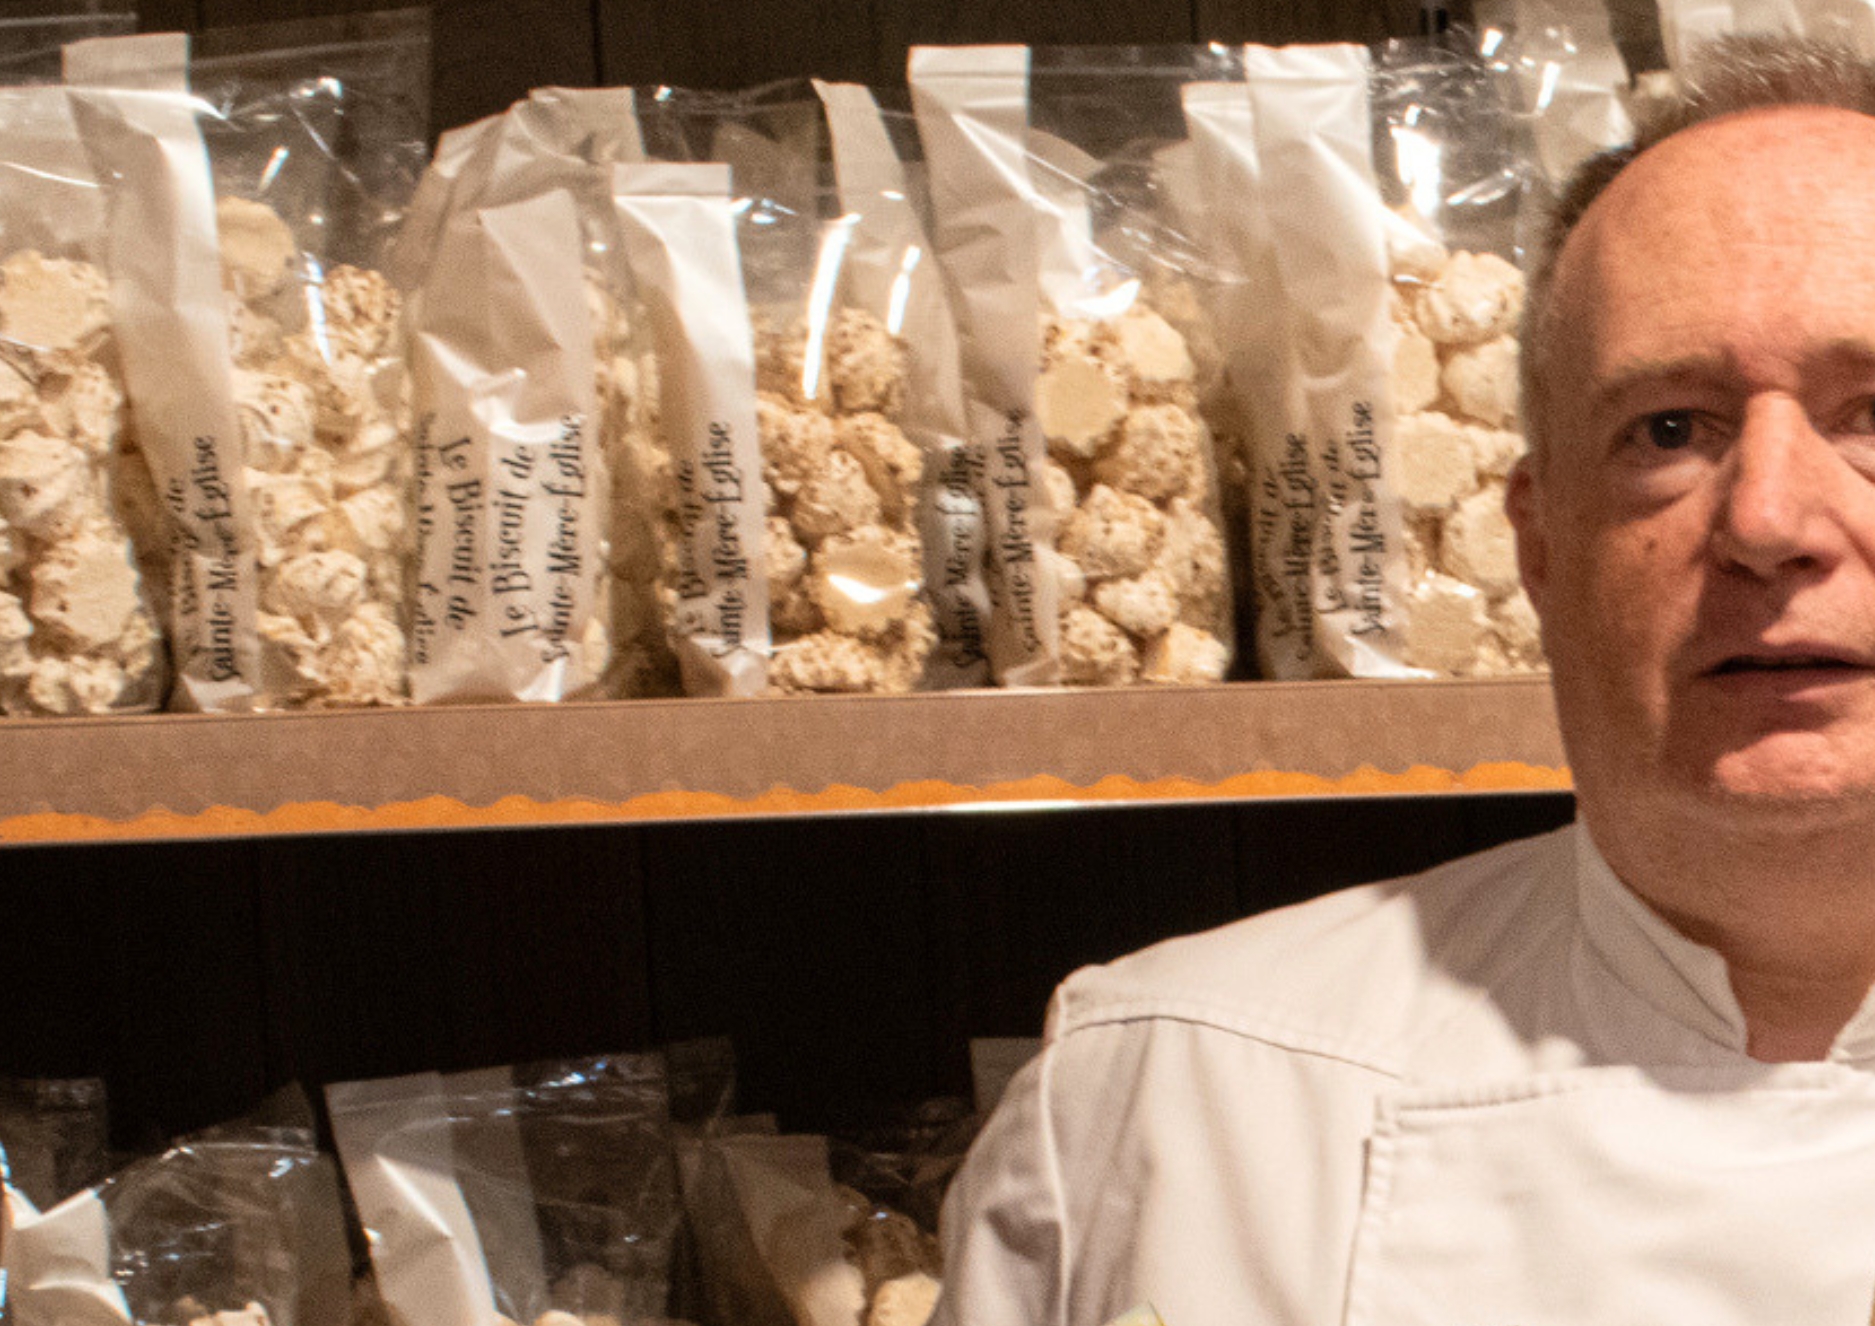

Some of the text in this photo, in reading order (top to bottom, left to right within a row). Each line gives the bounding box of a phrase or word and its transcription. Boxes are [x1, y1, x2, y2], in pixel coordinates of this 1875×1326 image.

[438, 437, 483, 631] Le Biscuit de
[488, 445, 539, 637] Le Biscuit de
